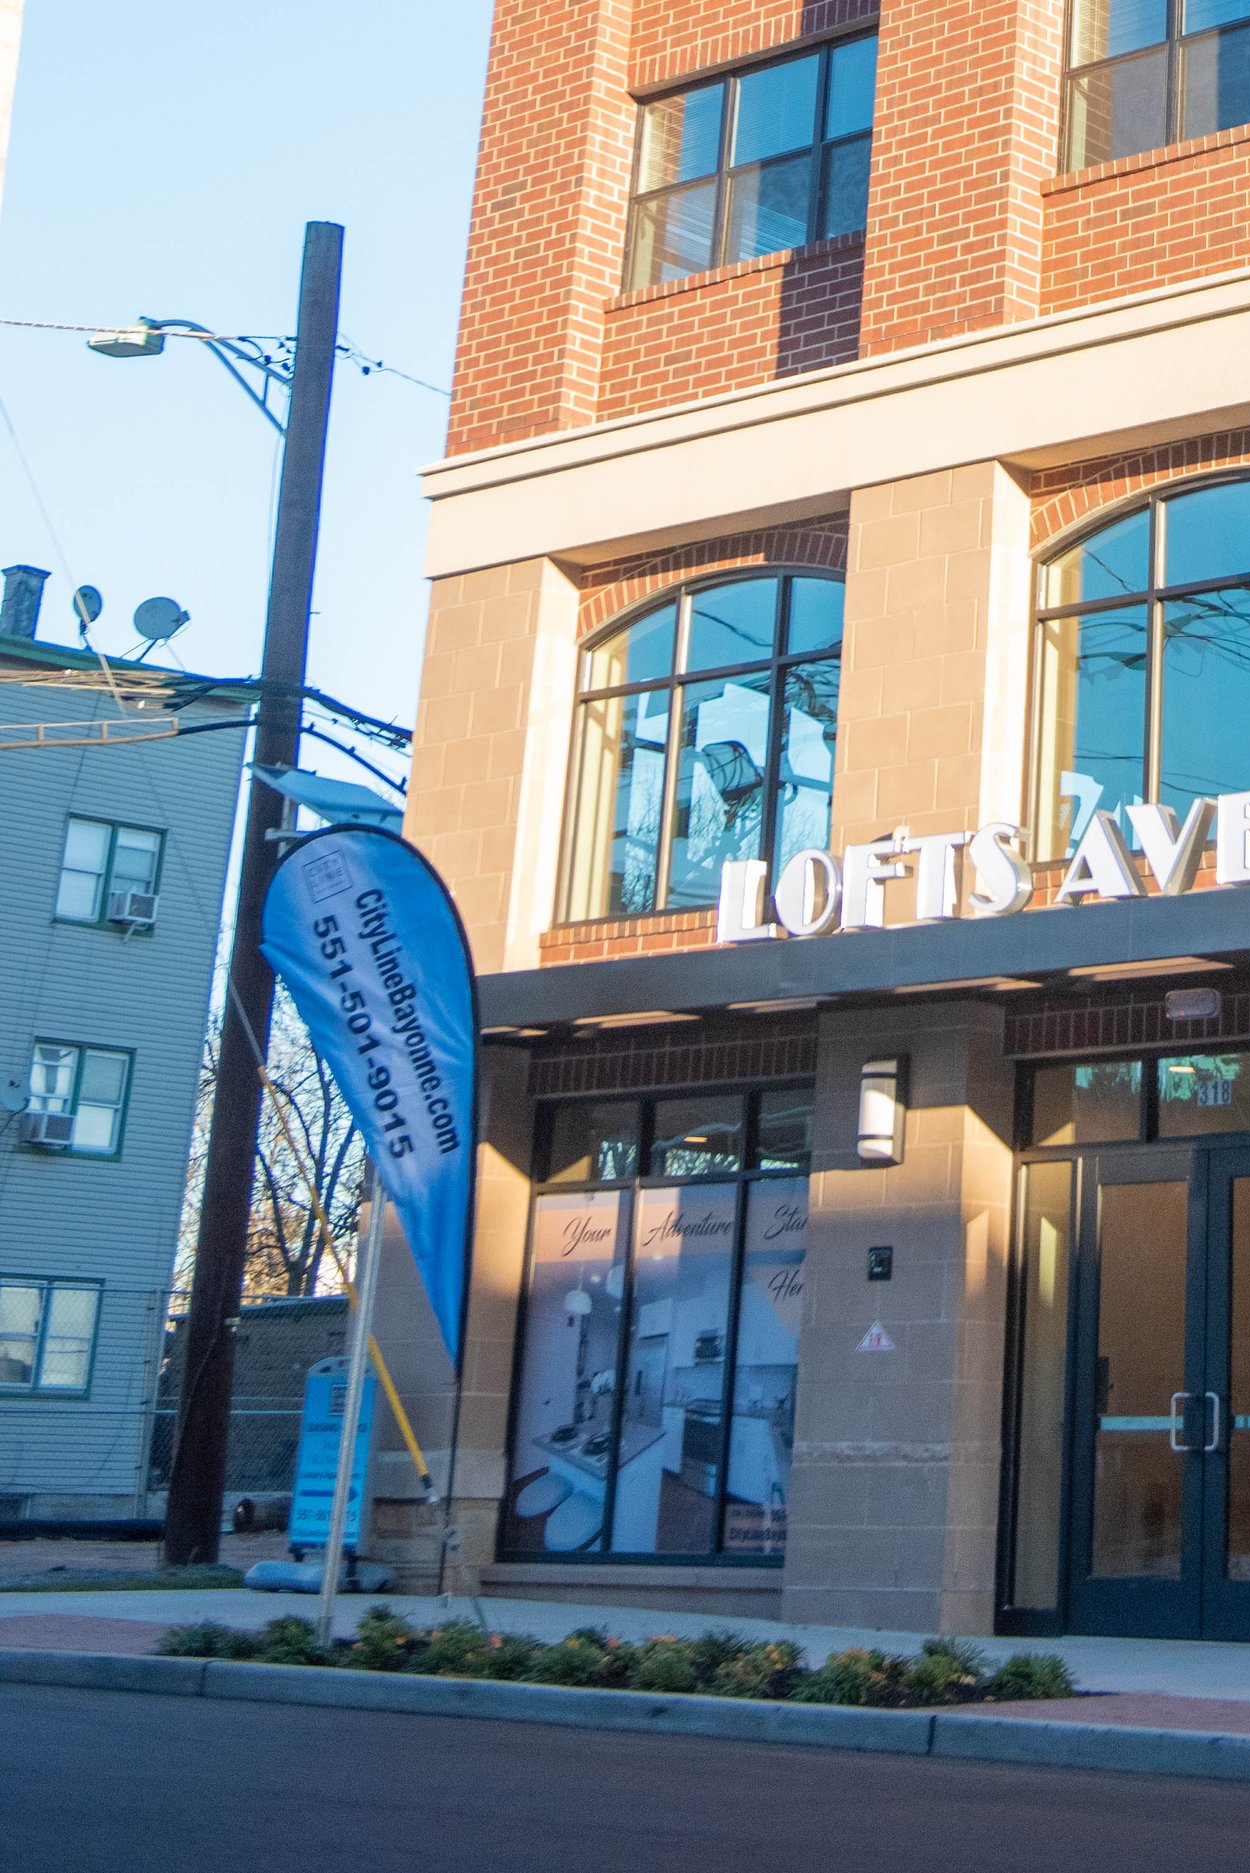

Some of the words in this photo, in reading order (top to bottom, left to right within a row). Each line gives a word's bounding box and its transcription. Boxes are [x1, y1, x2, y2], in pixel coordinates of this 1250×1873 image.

[717, 821, 1033, 944] LOFTS
[313, 914, 415, 1159] 551-501-9015
[355, 888, 460, 1154] CityLineBayonne.com
[1199, 1080, 1231, 1105] 318
[561, 1215, 613, 1257] Your
[642, 1211, 736, 1247] Adventure
